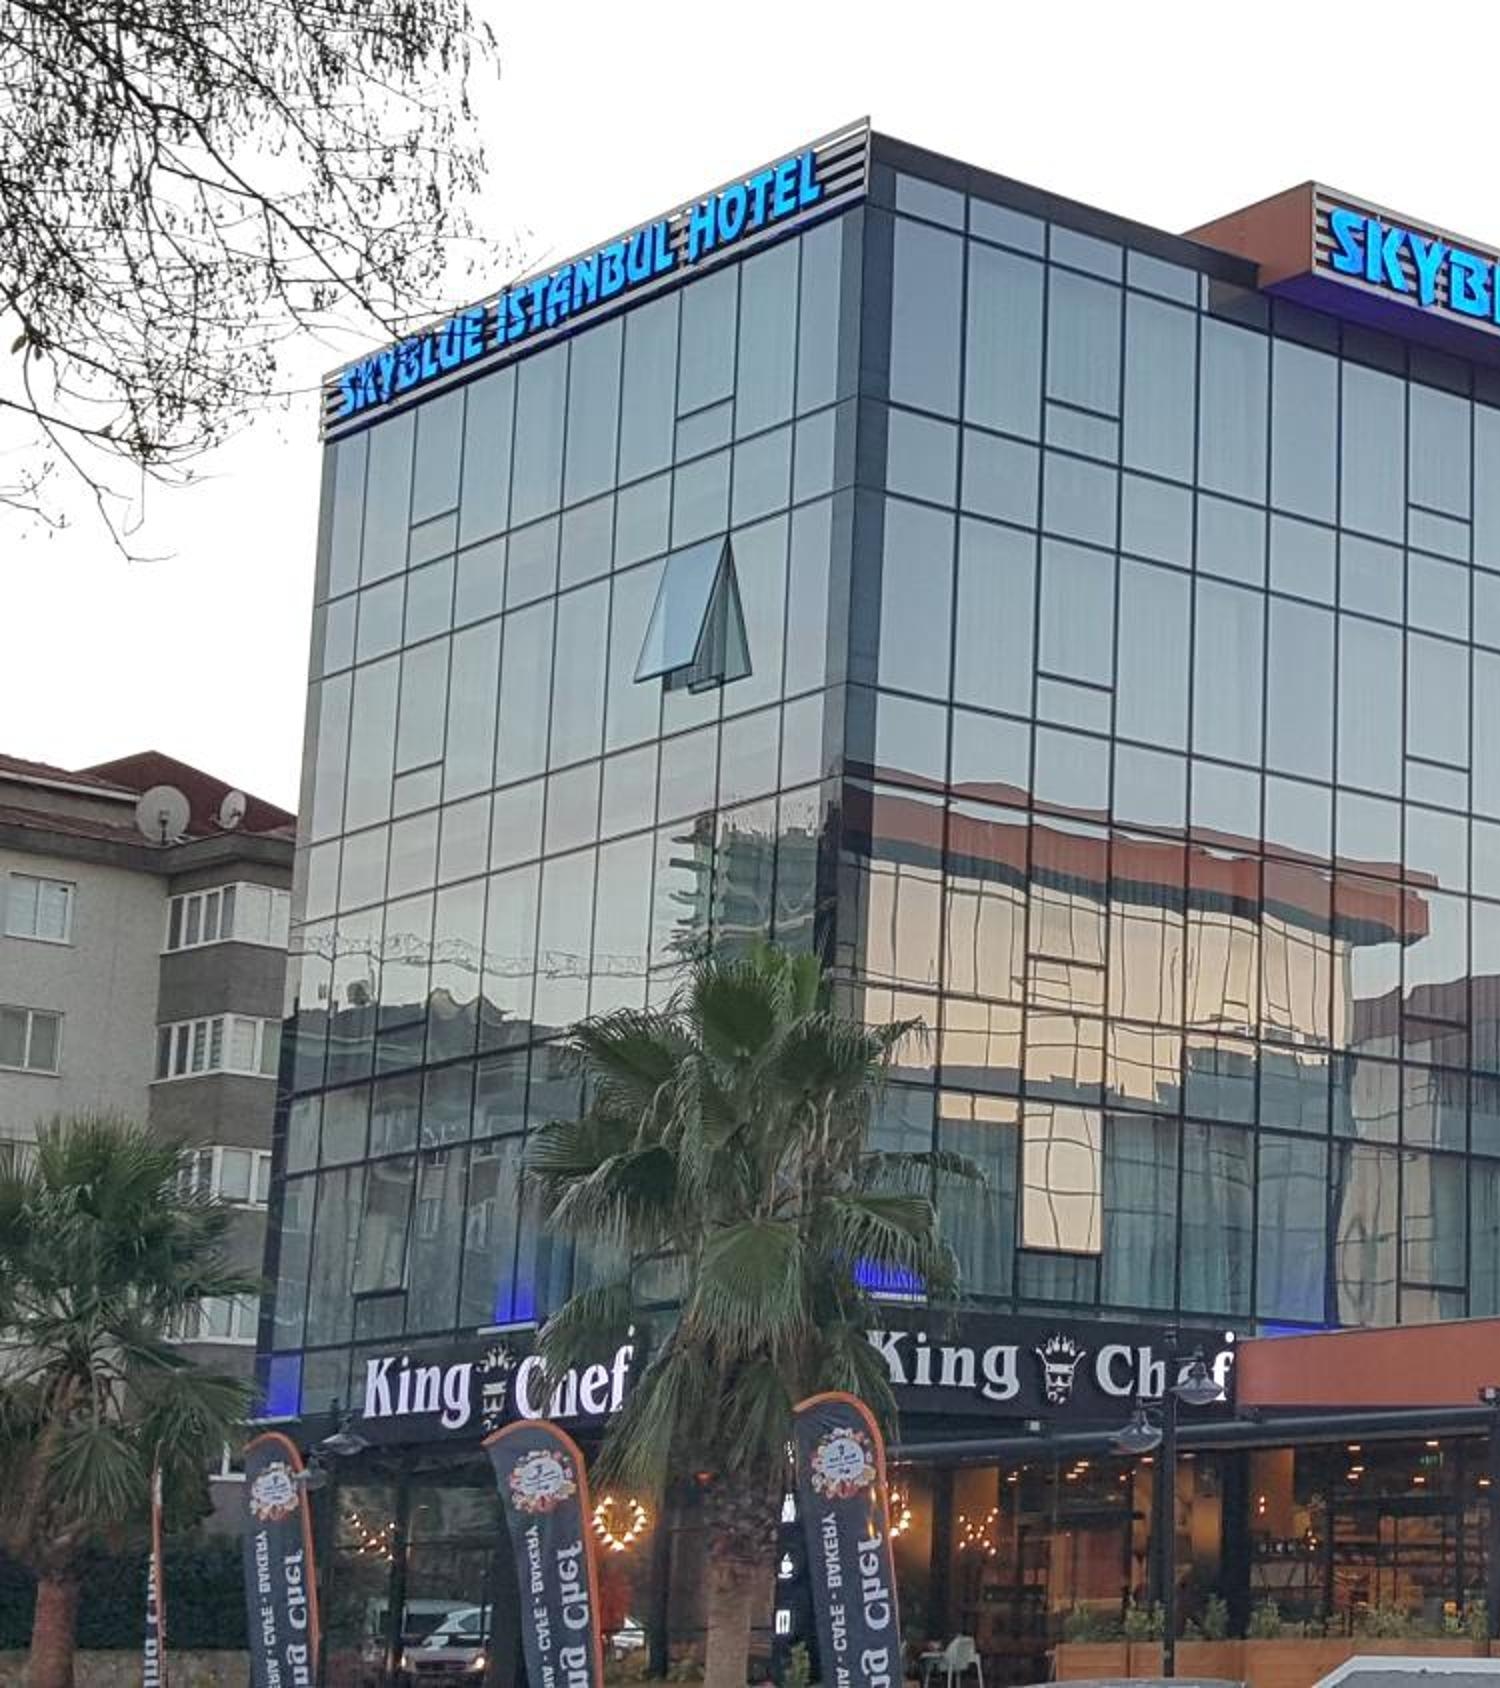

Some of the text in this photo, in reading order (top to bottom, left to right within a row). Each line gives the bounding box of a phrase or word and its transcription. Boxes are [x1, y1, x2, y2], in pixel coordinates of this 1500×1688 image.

[335, 305, 488, 417] SKYBLUE
[685, 150, 822, 261] HOTEL
[362, 1355, 473, 1430] King
[866, 1328, 1022, 1401] King
